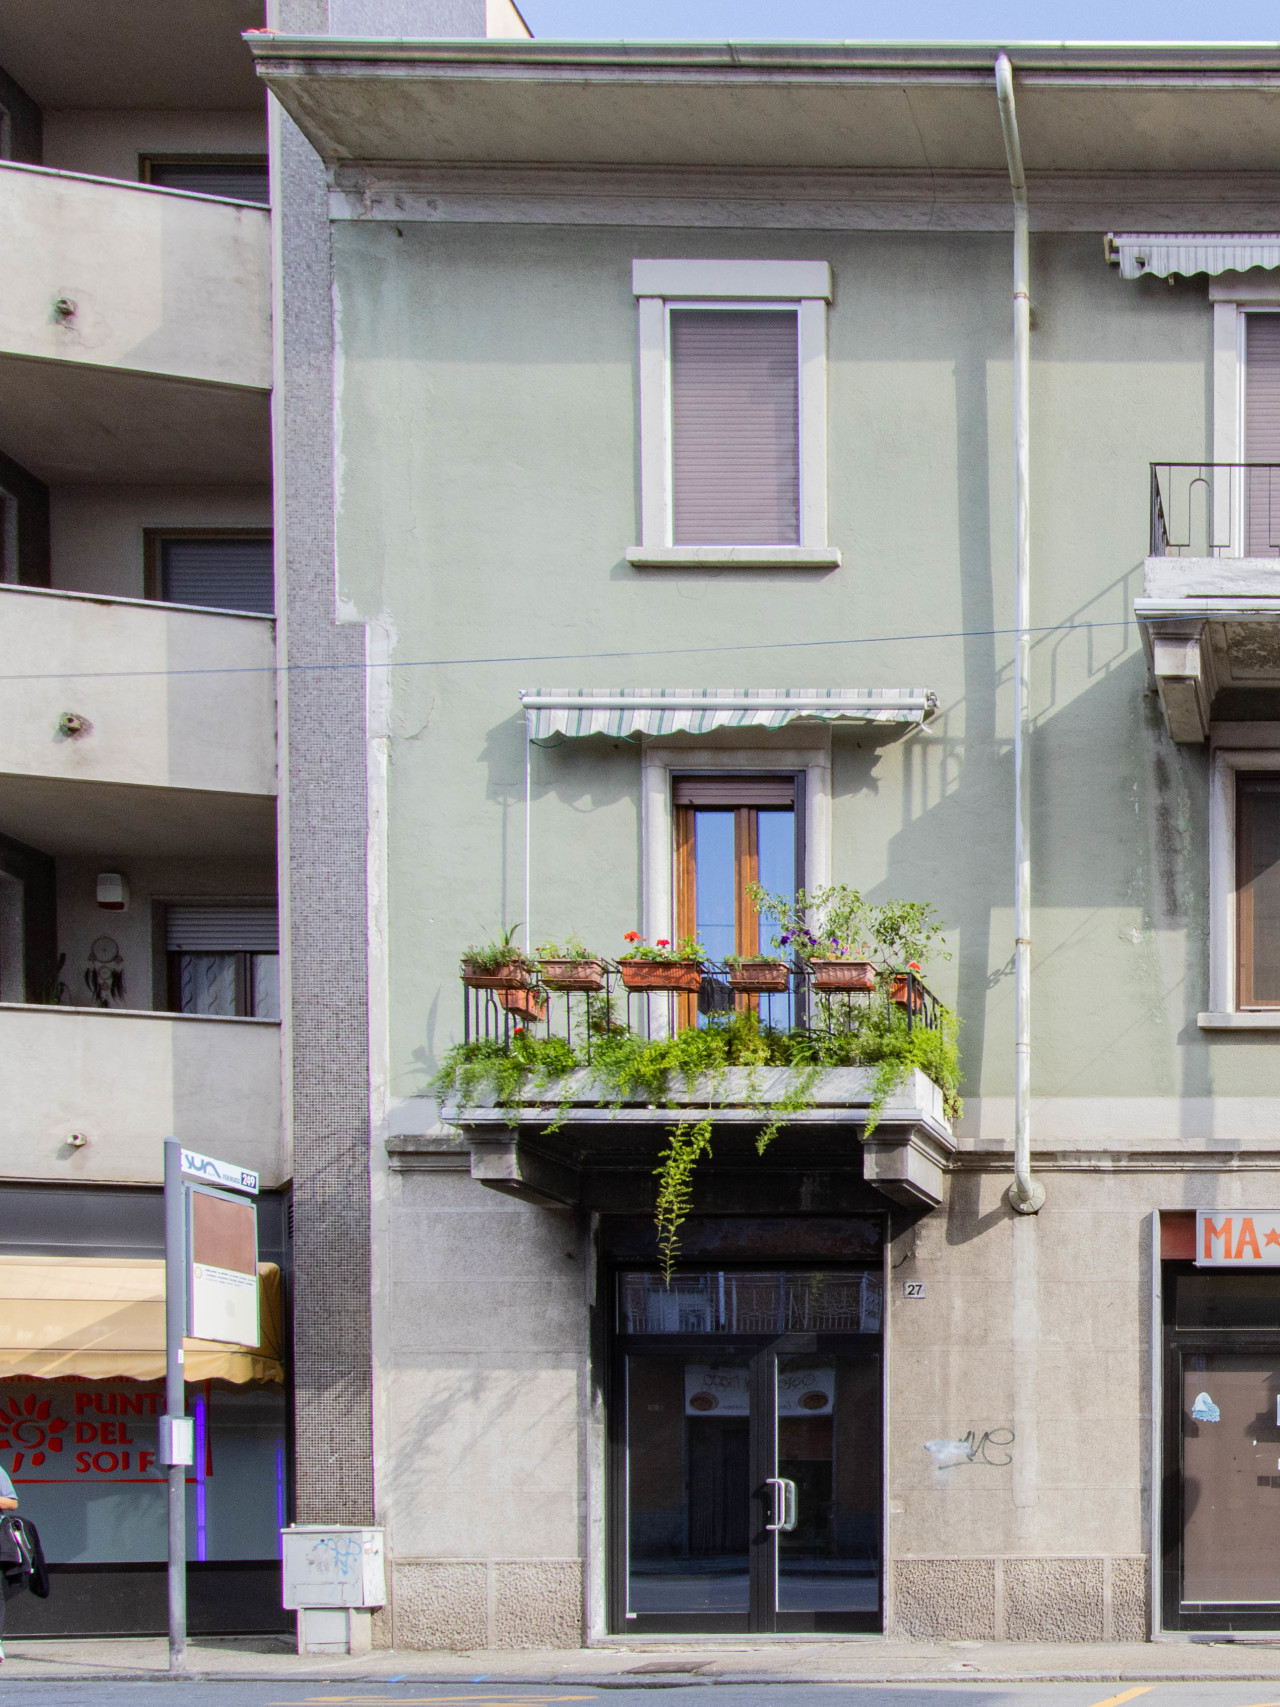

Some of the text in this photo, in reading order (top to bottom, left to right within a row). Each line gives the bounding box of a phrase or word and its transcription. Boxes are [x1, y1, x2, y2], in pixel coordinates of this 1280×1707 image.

[242, 1173, 255, 1188] 249
[907, 1284, 923, 1296] 27
[75, 1392, 189, 1415] PUNT
[75, 1421, 133, 1445] DEL
